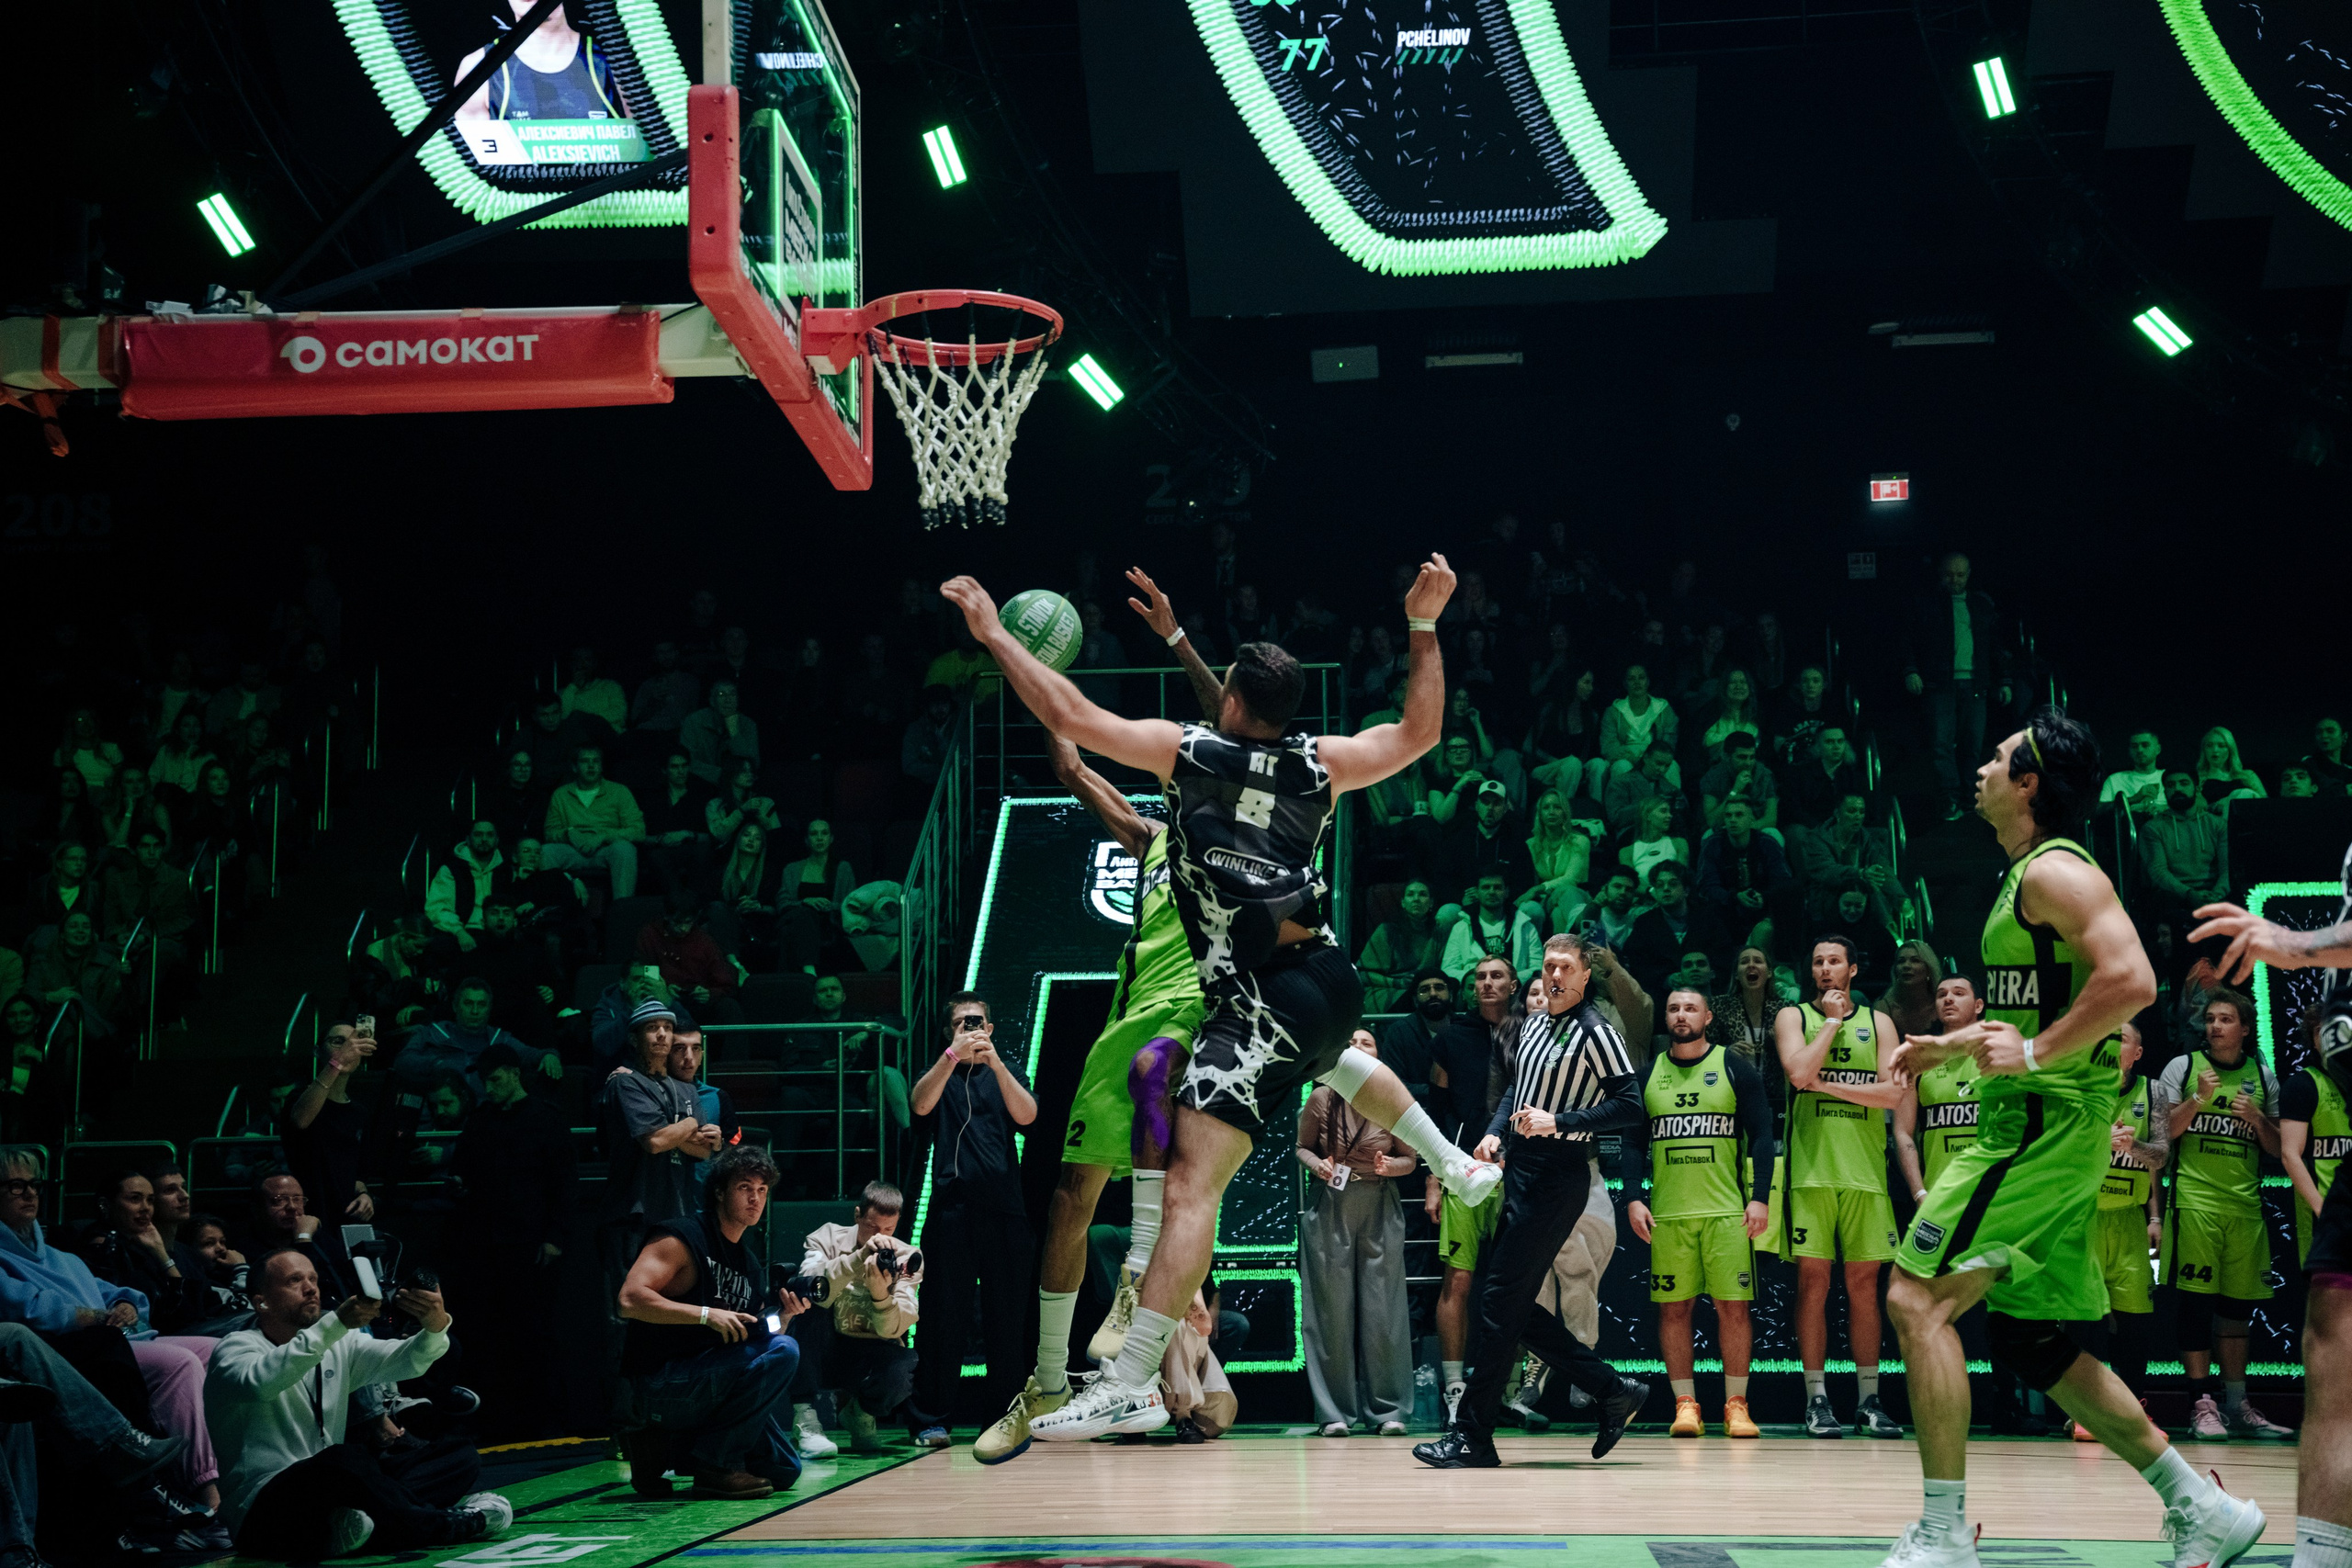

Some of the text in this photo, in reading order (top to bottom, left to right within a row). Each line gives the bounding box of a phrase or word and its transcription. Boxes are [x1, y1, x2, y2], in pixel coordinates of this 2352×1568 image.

[1396, 28, 1471, 47] PCHELINOV
[1278, 38, 1328, 71] 77
[517, 124, 636, 141] АЛЕКСИЕВИЧ ПАВЕЛ
[481, 140, 498, 153] 3
[532, 144, 621, 162] ALEKSIEVICH
[1017, 598, 1056, 637] STAVOK
[1047, 612, 1075, 651] BASKET
[1235, 787, 1276, 829] 8
[1211, 852, 1276, 877] WINLINE
[1829, 1047, 1851, 1063] 13
[1674, 1092, 1700, 1108] 33
[1067, 1120, 1086, 1146] 2
[2180, 1263, 2213, 1282] 44
[1651, 1274, 1675, 1292] 33
